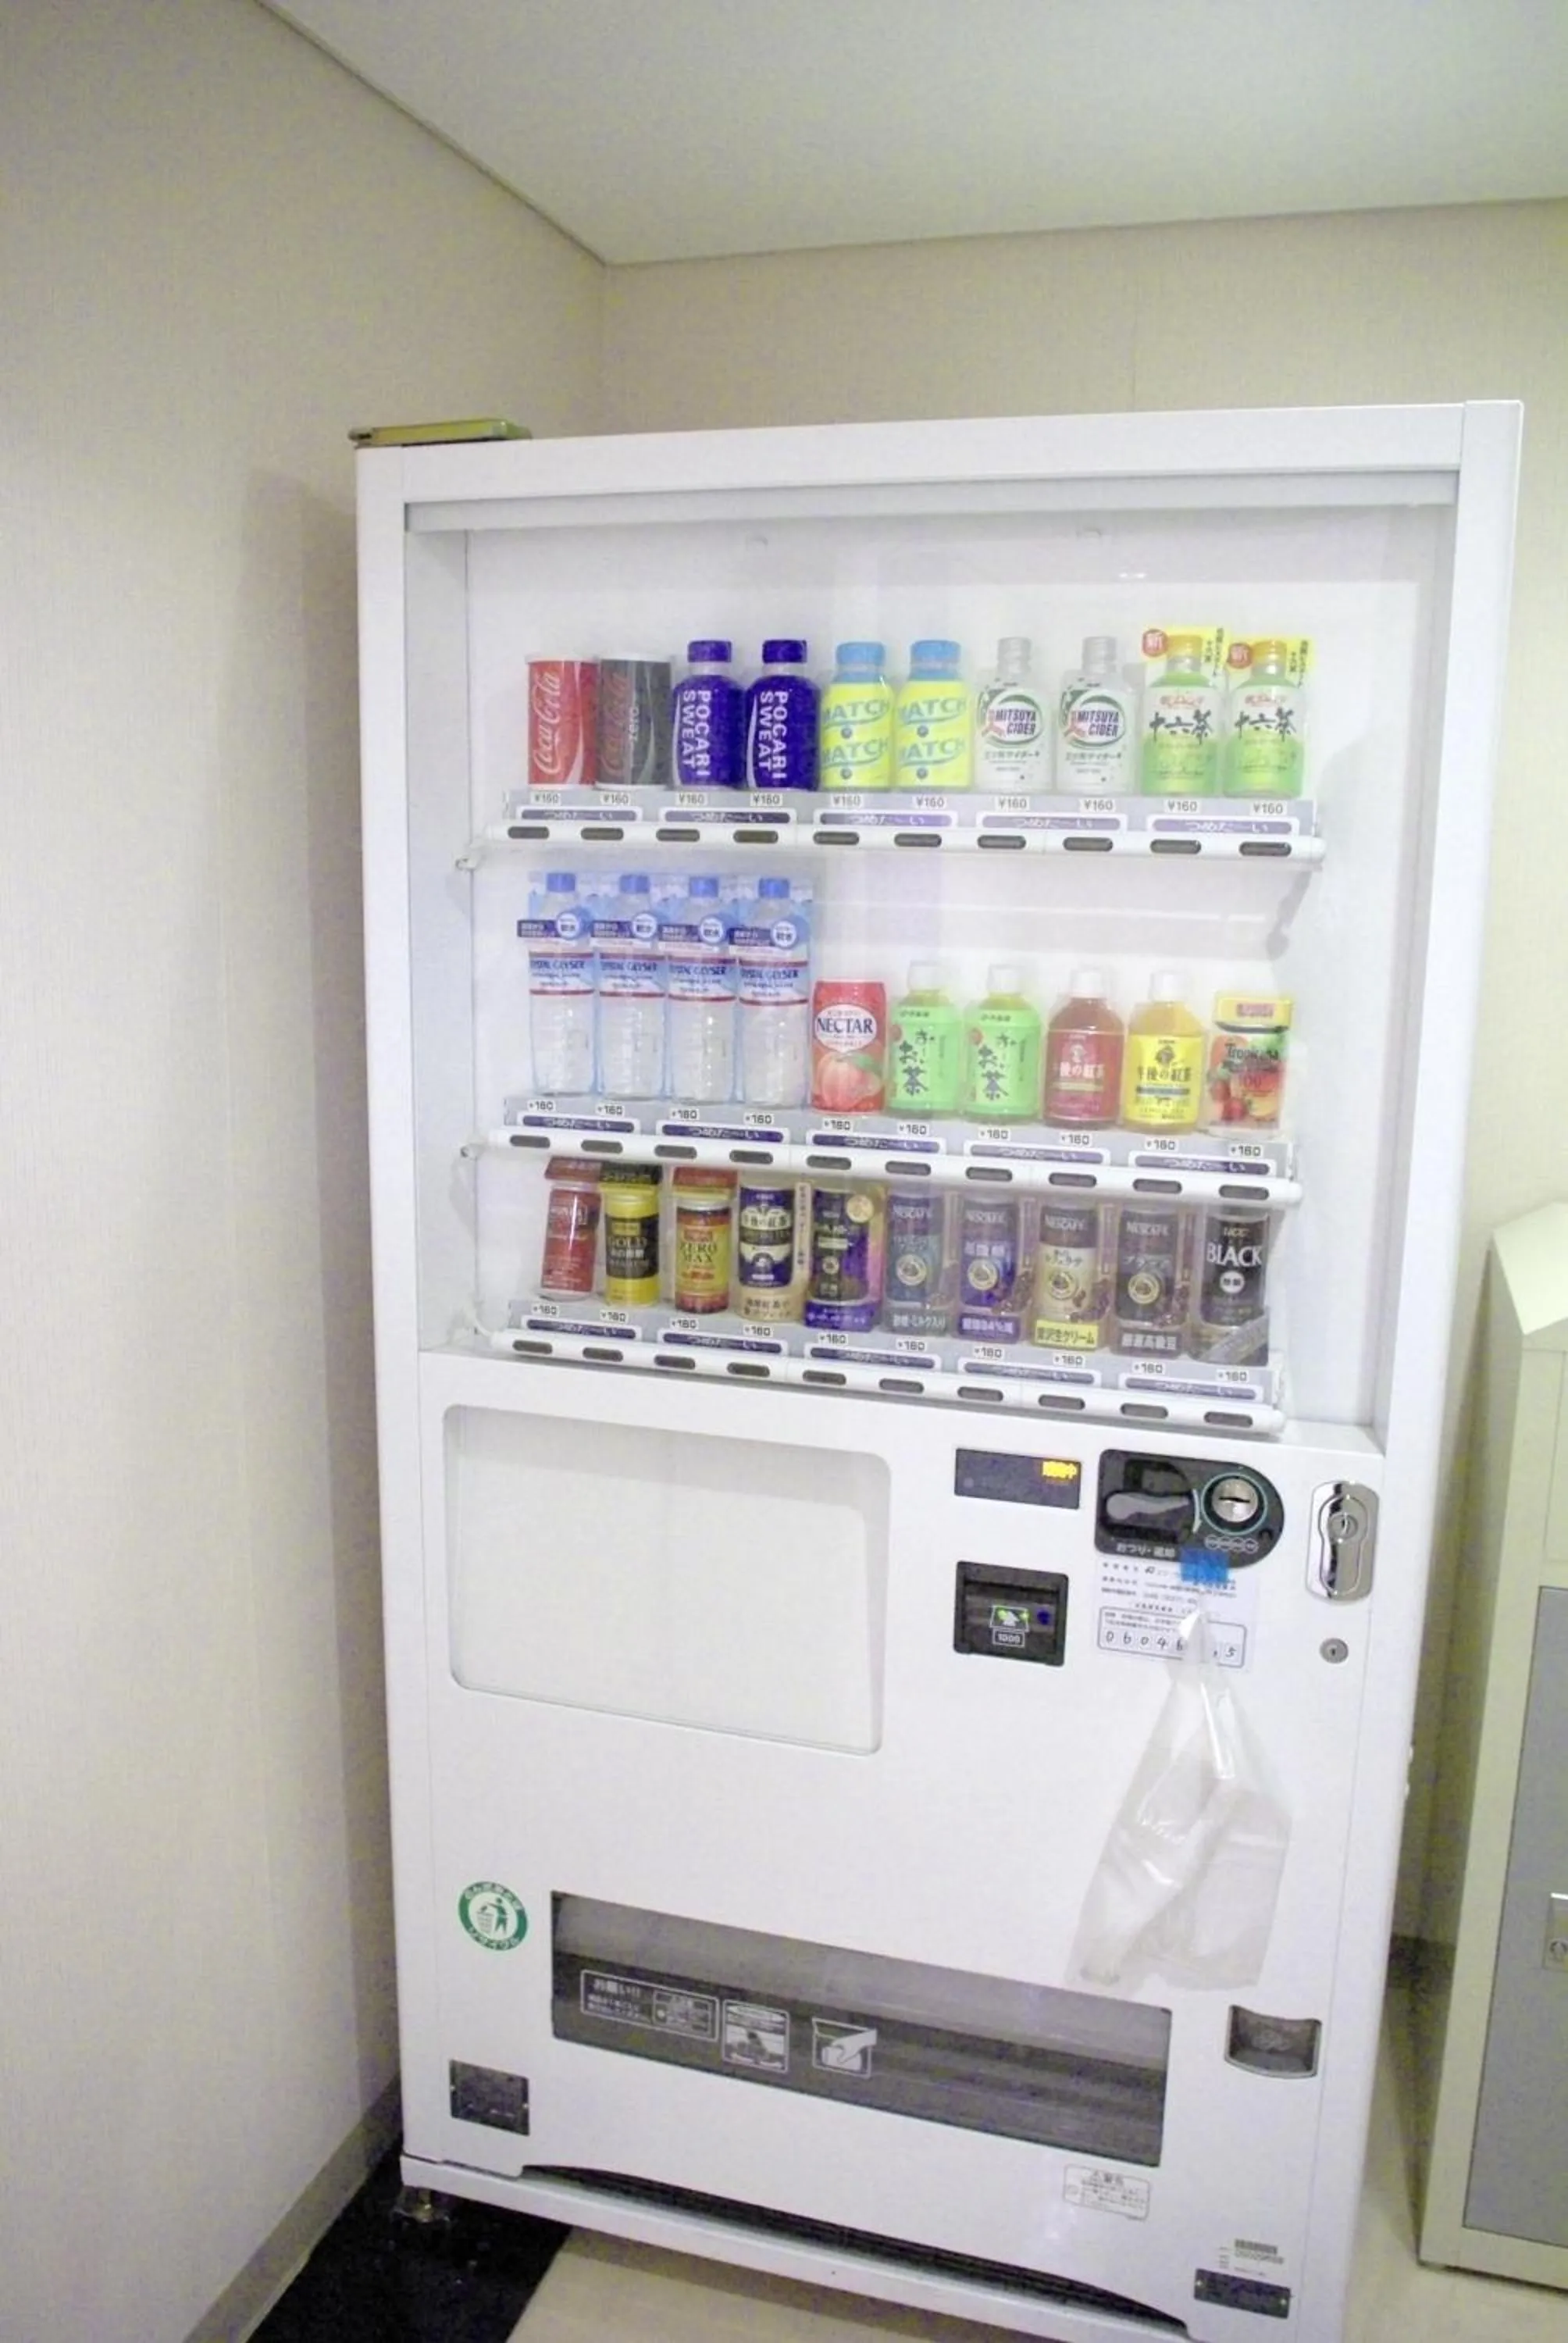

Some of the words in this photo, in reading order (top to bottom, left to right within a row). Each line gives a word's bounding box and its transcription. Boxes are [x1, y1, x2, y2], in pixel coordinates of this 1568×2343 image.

[996, 709, 1036, 722] MITSUYA
[1078, 710, 1119, 722] MITSUYA
[682, 690, 696, 769] SWEAT
[694, 690, 711, 776] POCARI
[758, 690, 774, 772] SWEAT
[1007, 723, 1036, 735] CIDER
[1088, 724, 1118, 737] CIDER
[772, 691, 789, 779] POCARI
[534, 795, 558, 804] ¥160
[604, 795, 629, 804] ¥160
[679, 794, 704, 804] ¥160
[754, 795, 779, 804] ¥160
[833, 796, 861, 805] ¥160
[917, 797, 944, 806] ¥160
[1000, 799, 1026, 808] ¥160
[1084, 800, 1113, 810] ¥160
[1169, 801, 1197, 811] ¥160
[1253, 804, 1283, 813] ¥160
[817, 1018, 873, 1034] NECTAR
[1206, 1240, 1262, 1267] BLACK
